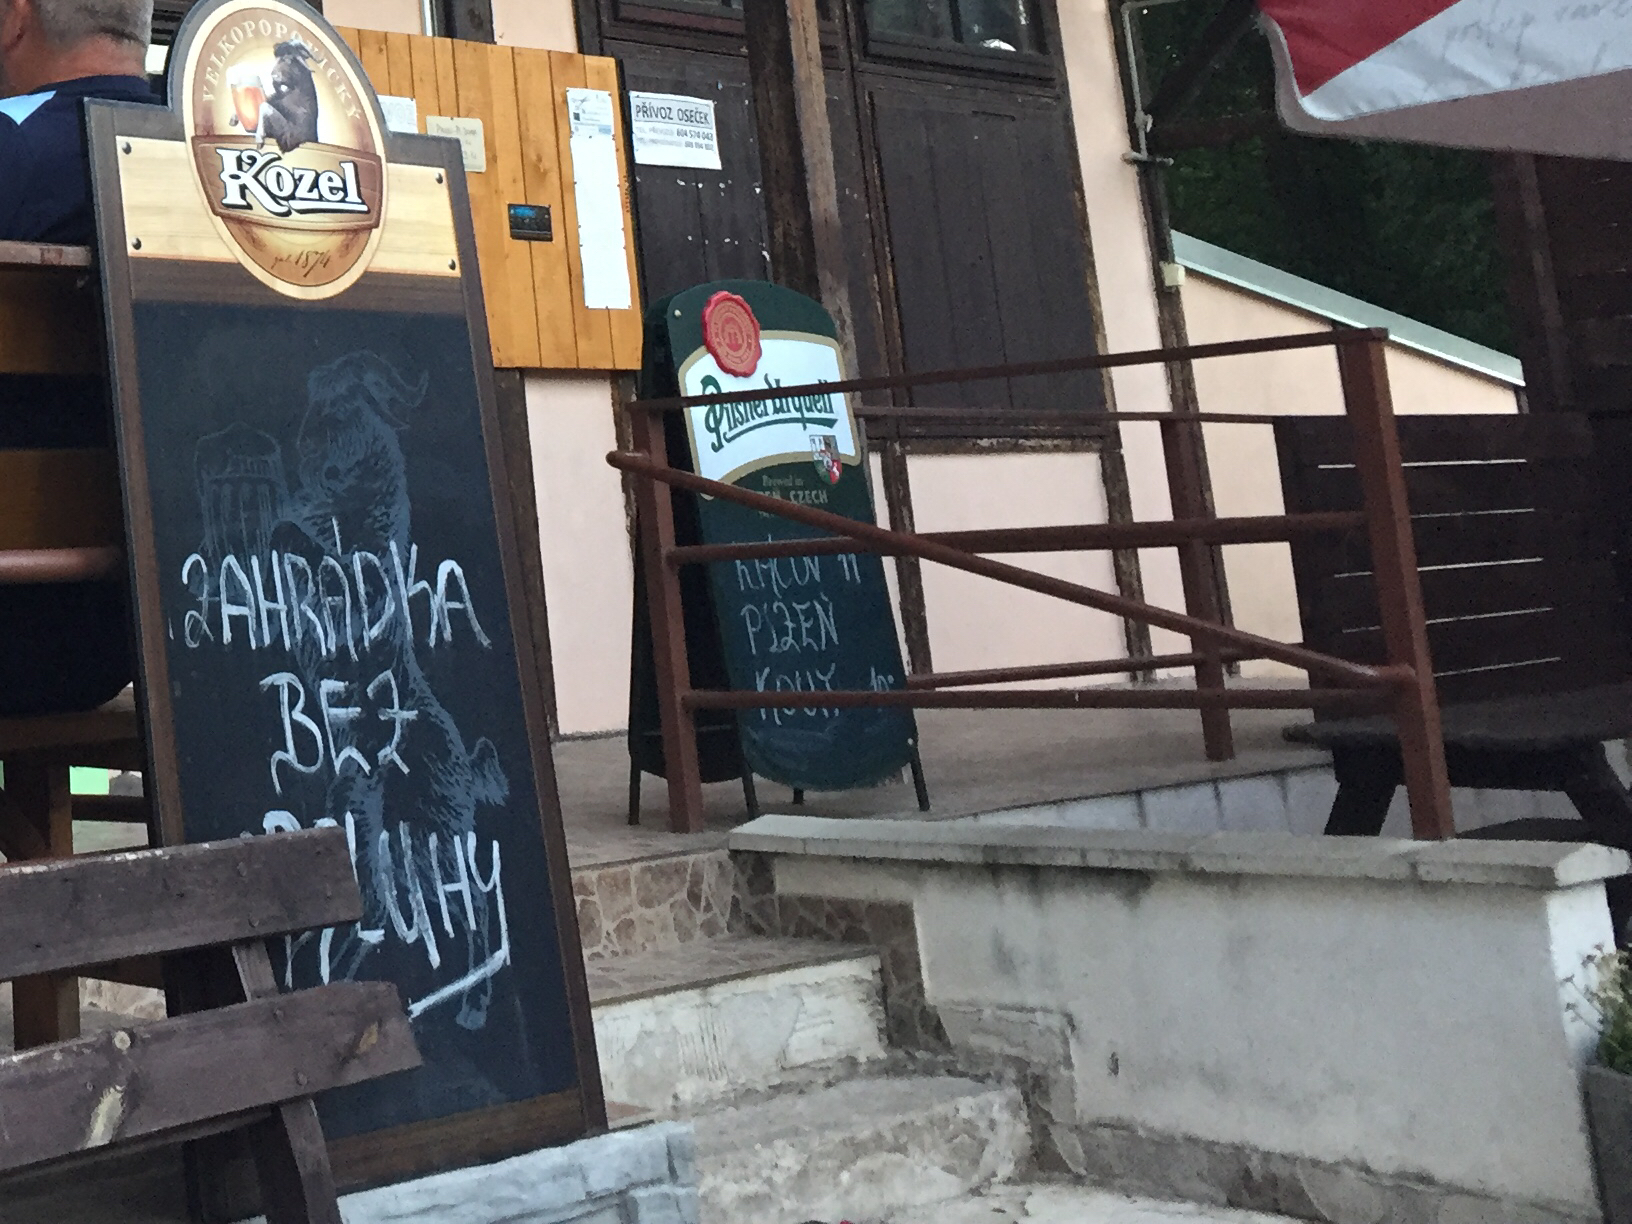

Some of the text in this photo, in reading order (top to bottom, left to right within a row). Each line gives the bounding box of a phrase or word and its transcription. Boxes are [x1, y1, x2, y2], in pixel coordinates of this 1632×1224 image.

[635, 101, 673, 121] PŘÍVOZ
[216, 147, 369, 217] Kozel
[259, 668, 419, 796] BEZ
